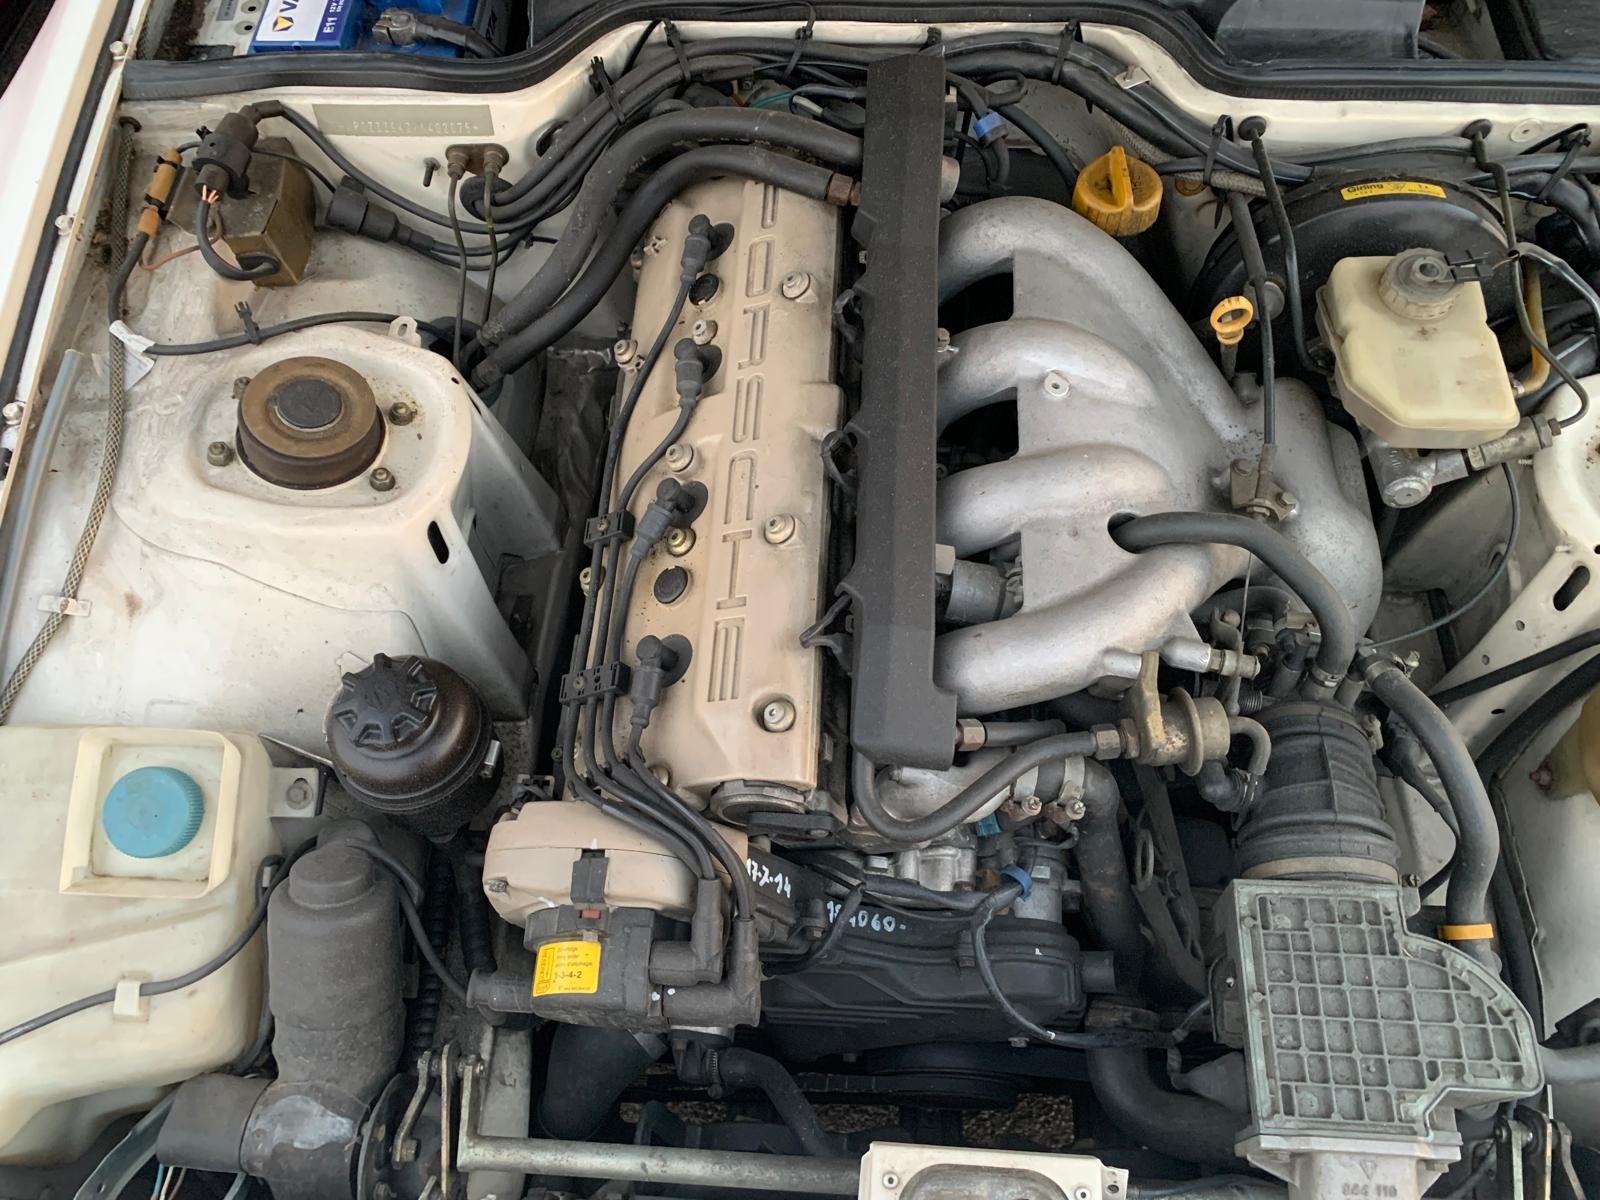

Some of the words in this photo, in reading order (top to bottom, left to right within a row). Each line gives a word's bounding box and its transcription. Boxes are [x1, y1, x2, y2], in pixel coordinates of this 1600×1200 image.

[322, 17, 338, 33] E11
[1346, 183, 1384, 193] Girling
[707, 184, 779, 702] PORSCHE
